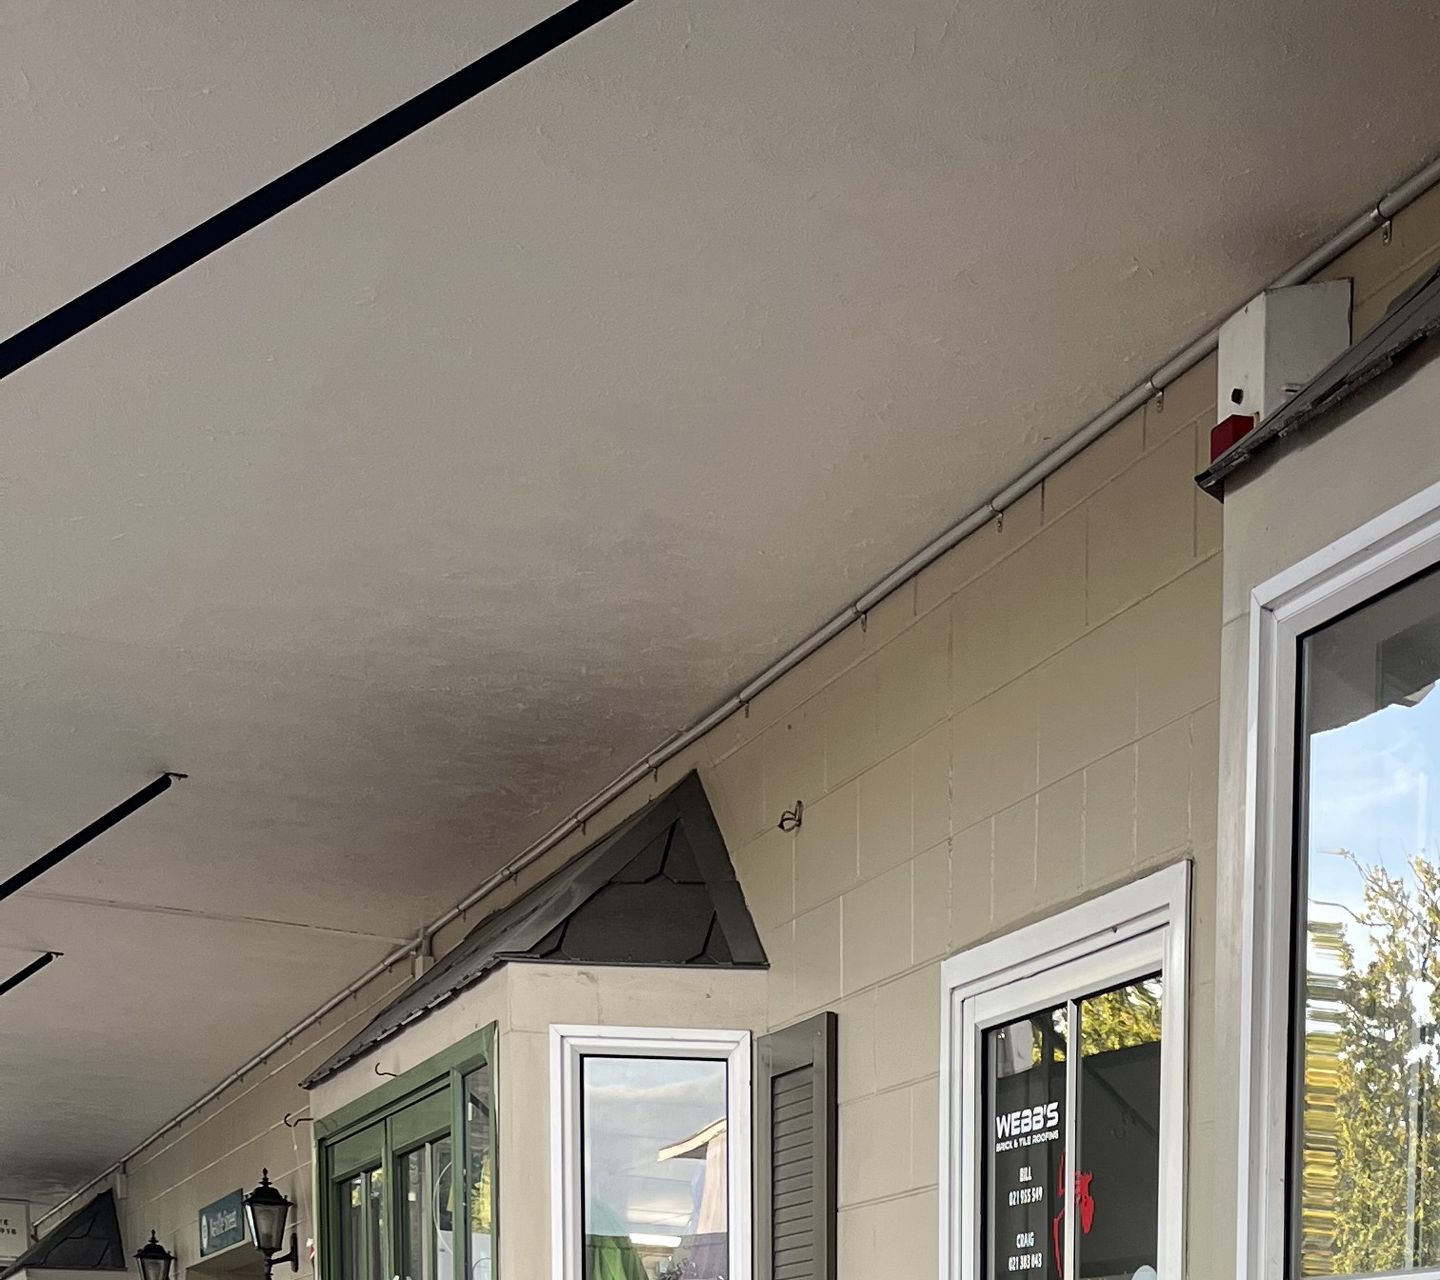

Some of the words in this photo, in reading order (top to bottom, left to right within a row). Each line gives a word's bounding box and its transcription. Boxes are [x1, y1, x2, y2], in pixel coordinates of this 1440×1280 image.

[996, 1101, 1059, 1139] WEBB'S
[996, 1140, 1013, 1153] BRICK
[1019, 1135, 1031, 1147] TILE
[1032, 1129, 1059, 1145] ROOFING
[1019, 1166, 1033, 1182] BILL
[1009, 1190, 1020, 1206] 021
[1016, 1231, 1035, 1249] CRAIG
[1008, 1256, 1019, 1271] 021
